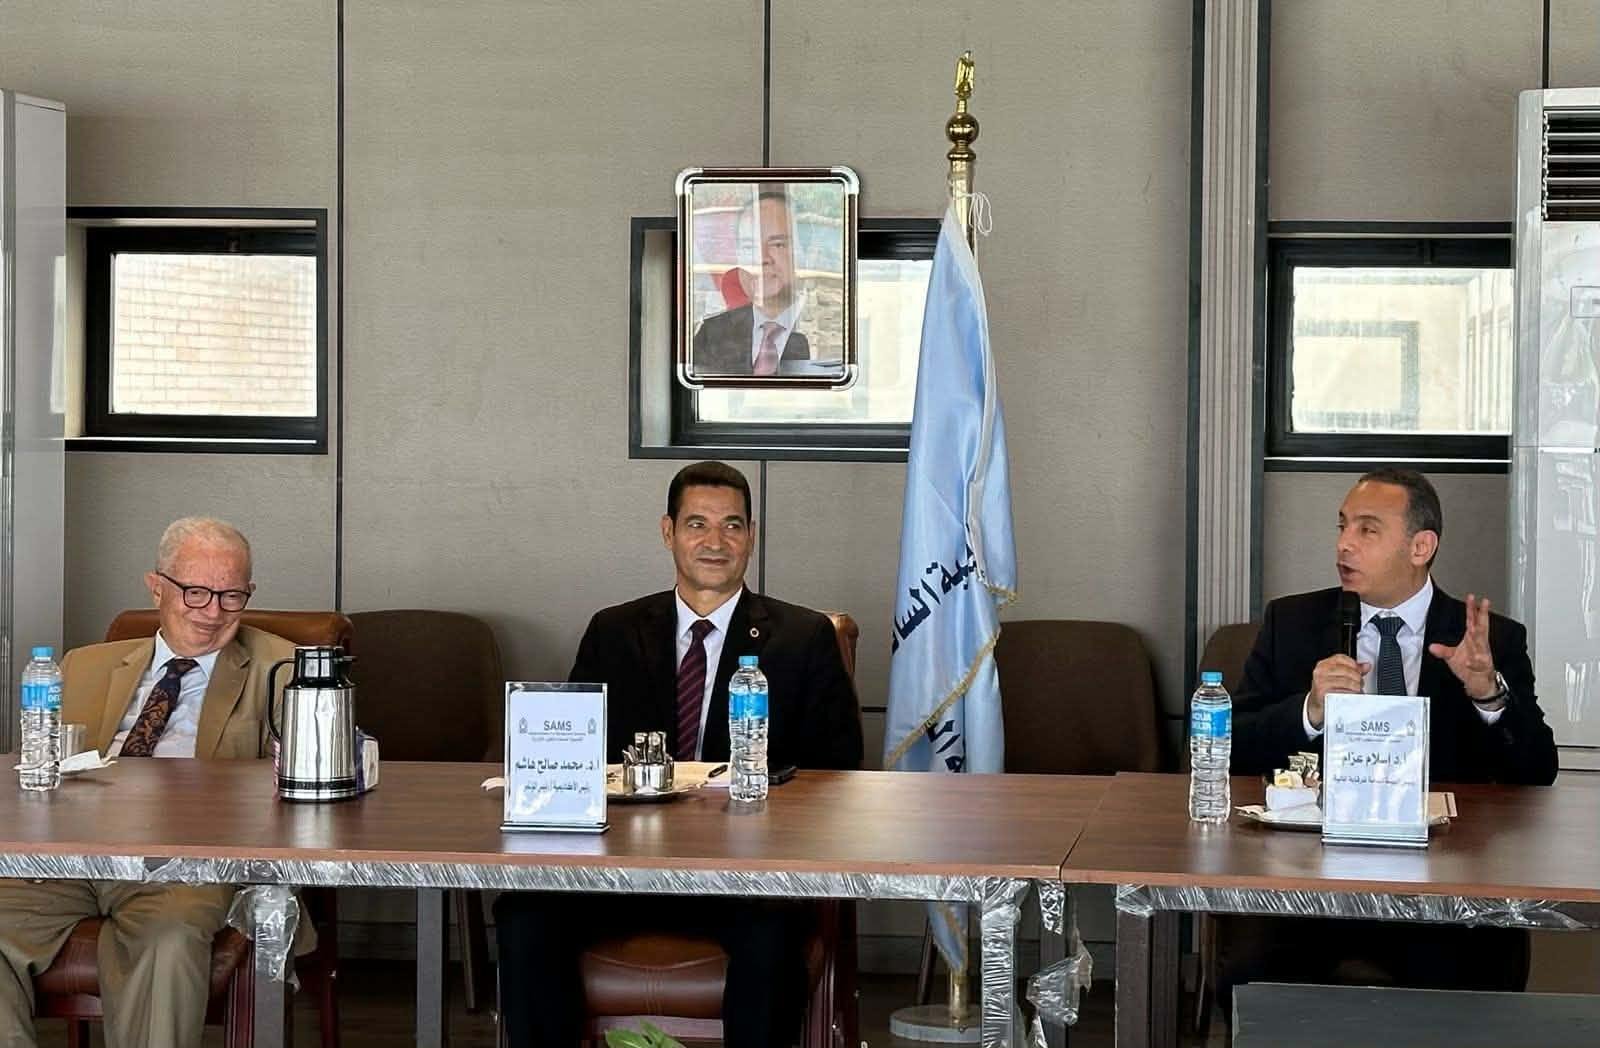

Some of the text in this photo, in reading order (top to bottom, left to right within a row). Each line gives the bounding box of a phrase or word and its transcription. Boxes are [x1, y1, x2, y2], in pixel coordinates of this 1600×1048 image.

[543, 719, 572, 732] SAMS
[1360, 720, 1391, 733] SAMS
[537, 757, 559, 774] صالح
[560, 759, 584, 771] محمد
